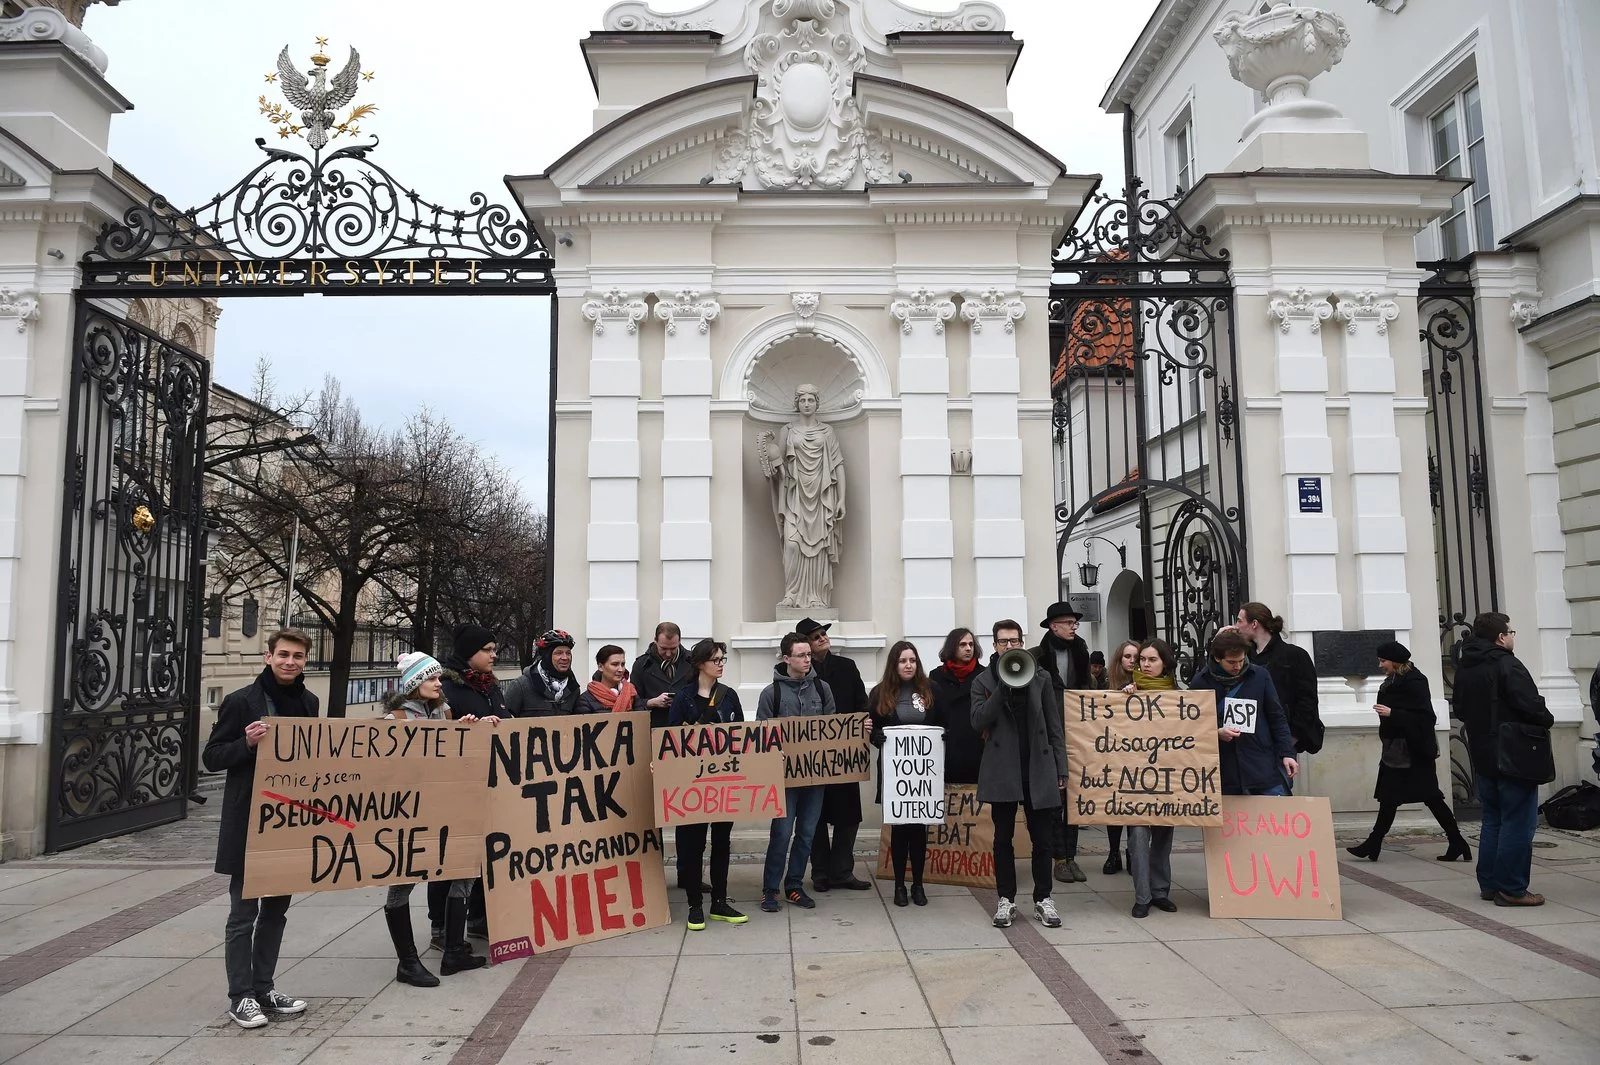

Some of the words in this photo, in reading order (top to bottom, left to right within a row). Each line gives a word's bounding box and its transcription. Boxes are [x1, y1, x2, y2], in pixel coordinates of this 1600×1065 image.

[150, 260, 484, 287] UNIWERSYTET
[1078, 694, 1114, 722] It's
[1125, 694, 1166, 721] OK
[1177, 695, 1201, 720] to
[1224, 703, 1256, 728] ASP
[274, 723, 470, 762] UNIWERSYTET
[658, 725, 783, 760] AKADEMIA
[780, 714, 869, 743] NIWERSYTET
[487, 720, 635, 788] NAUKA
[895, 735, 932, 756] MIND
[1095, 726, 1196, 764] disagree
[696, 755, 740, 778] jest
[892, 758, 937, 777] YOUR
[1079, 764, 1114, 789] but
[1118, 766, 1176, 792] NOT
[1181, 766, 1218, 794] OK
[264, 772, 361, 792] miejscem
[896, 779, 932, 797] OWN
[258, 791, 421, 834] PSEUDONAUKI
[521, 771, 628, 833] TAK
[662, 784, 784, 823] KOBIETĄ
[891, 800, 945, 819] UTERUS
[1076, 794, 1096, 816] to
[1104, 791, 1220, 816] discriminate
[926, 822, 977, 846] EBAT
[1222, 810, 1312, 839] BRAWO
[310, 832, 362, 884] DA
[926, 849, 995, 877] PROPAGAN
[1224, 850, 1320, 899] UW!
[530, 861, 646, 948] NIE!
[494, 940, 529, 958] razem
